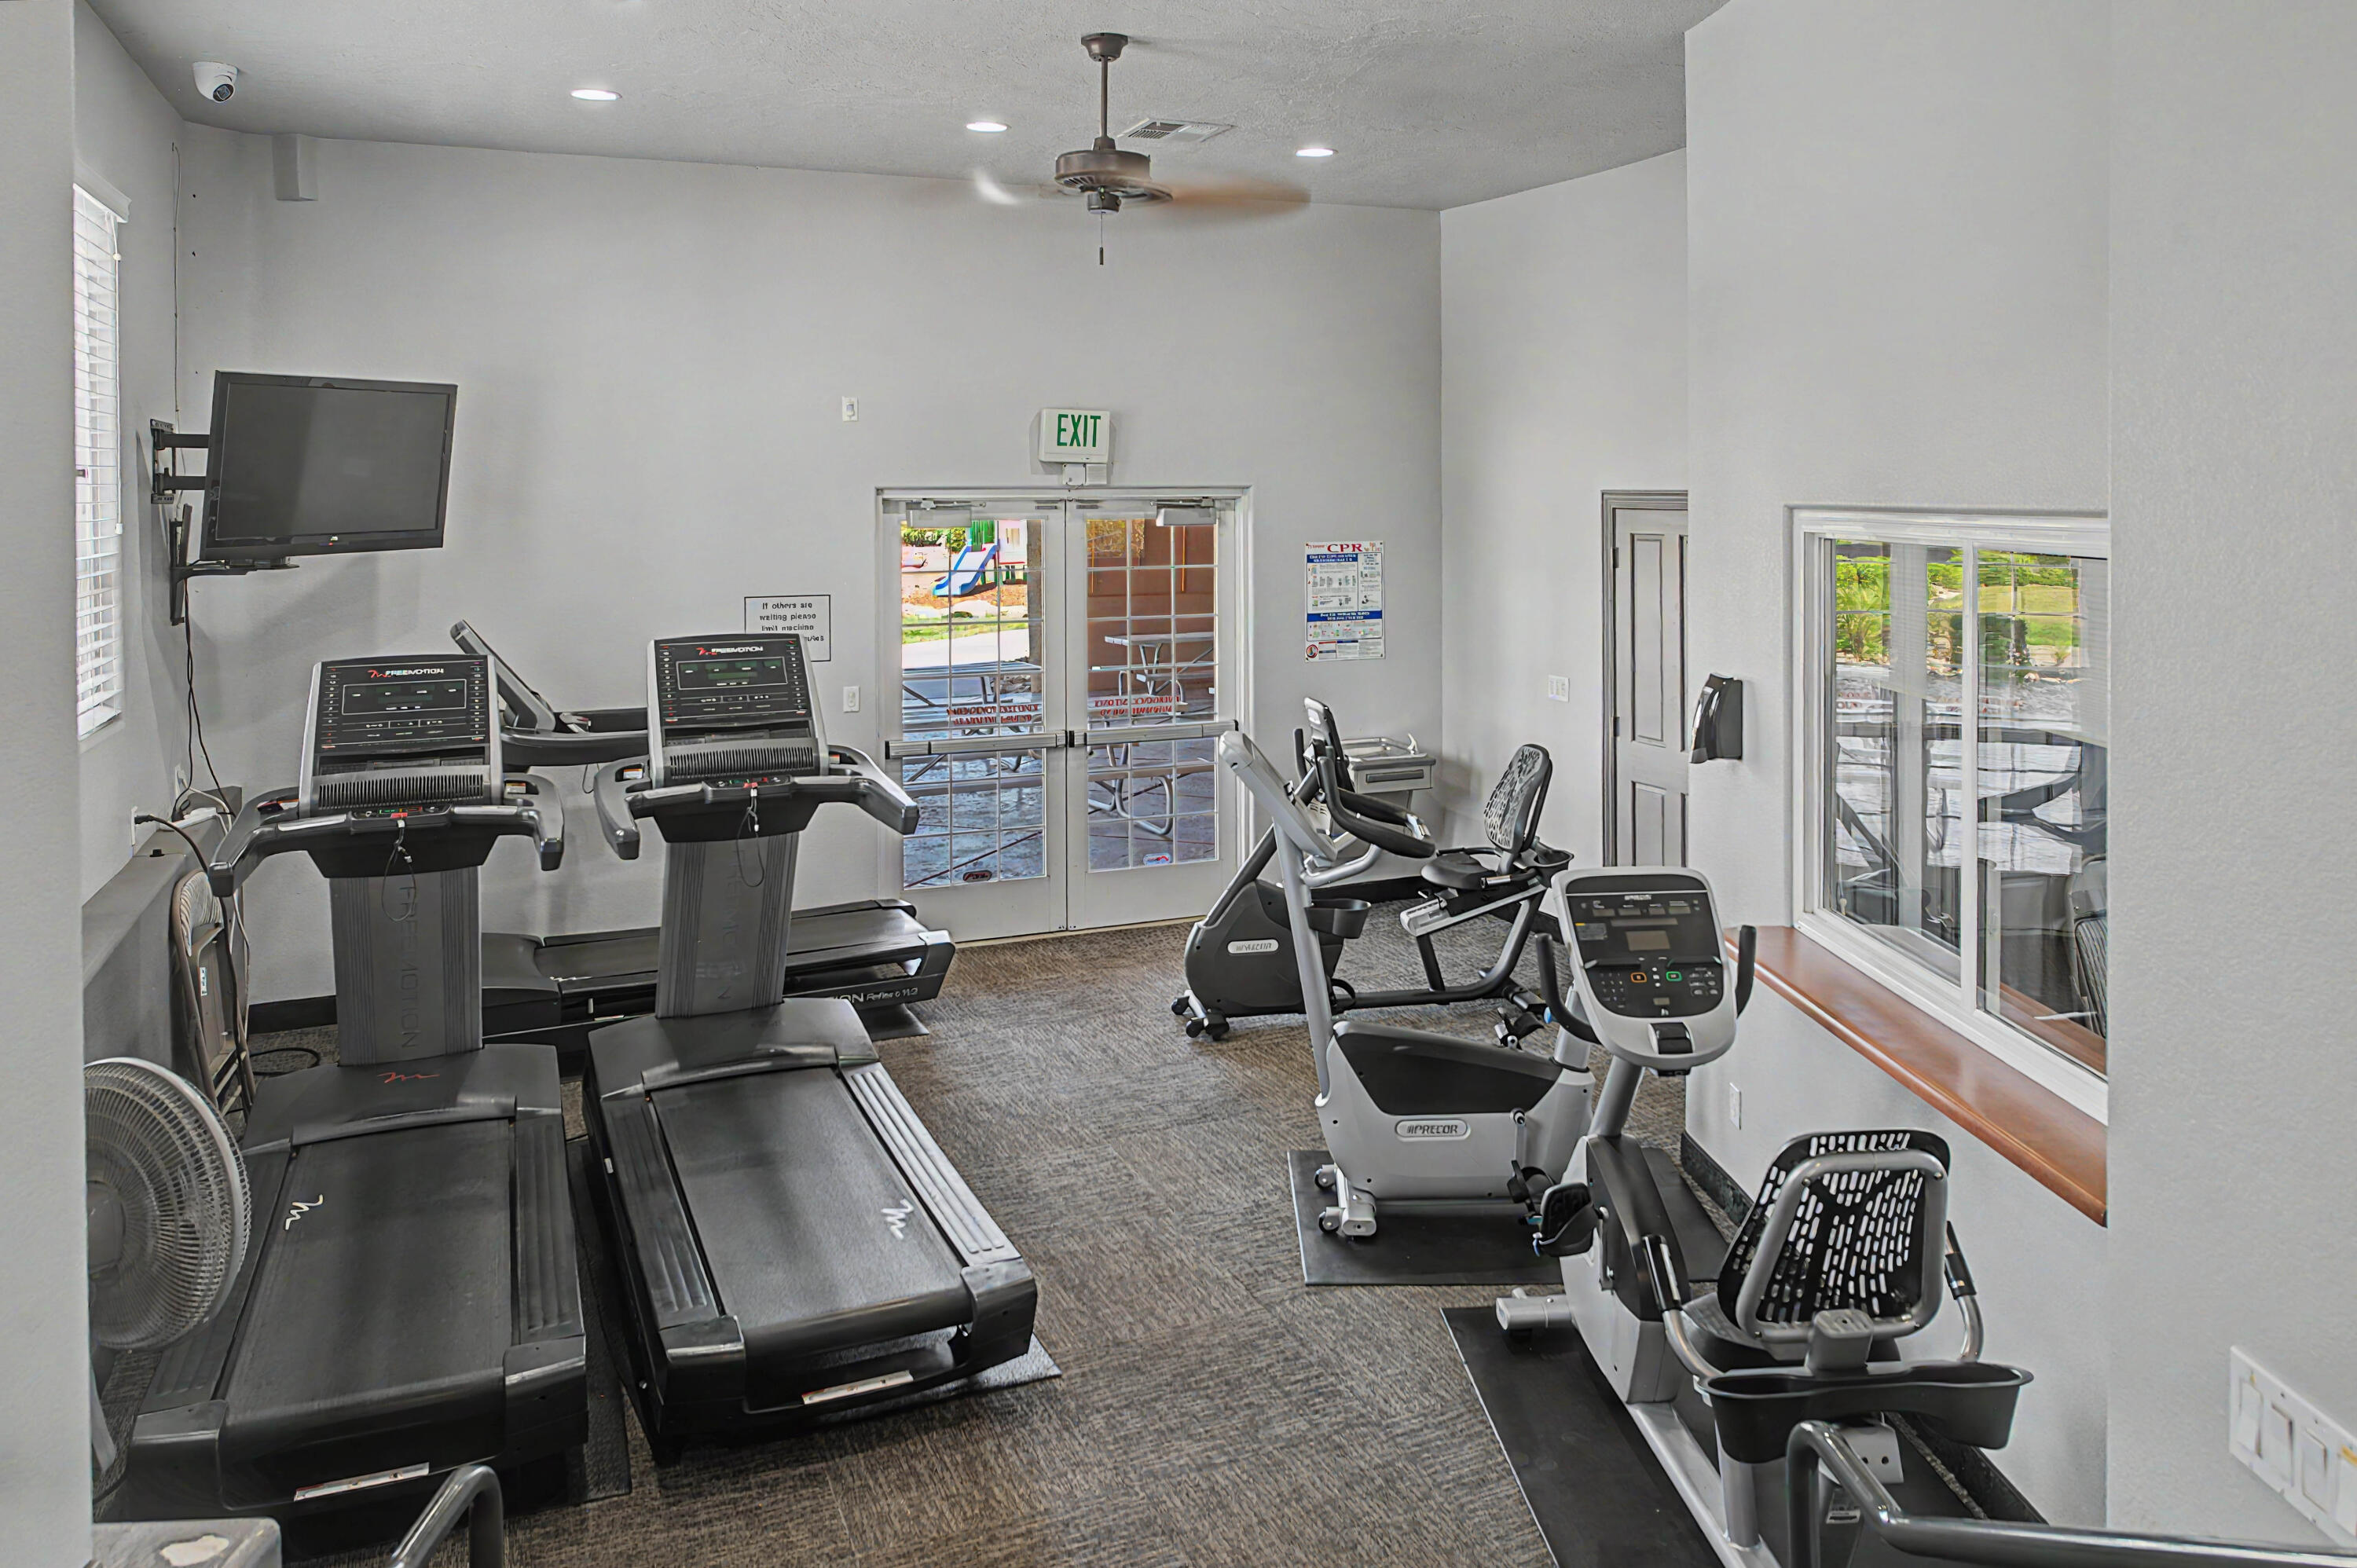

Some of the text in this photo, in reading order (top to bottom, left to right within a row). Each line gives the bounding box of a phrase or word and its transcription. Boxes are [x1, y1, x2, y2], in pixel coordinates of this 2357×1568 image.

[1057, 413, 1102, 447] EXIT
[1327, 544, 1362, 552] CPR
[1413, 1125, 1458, 1134] PRECOR
